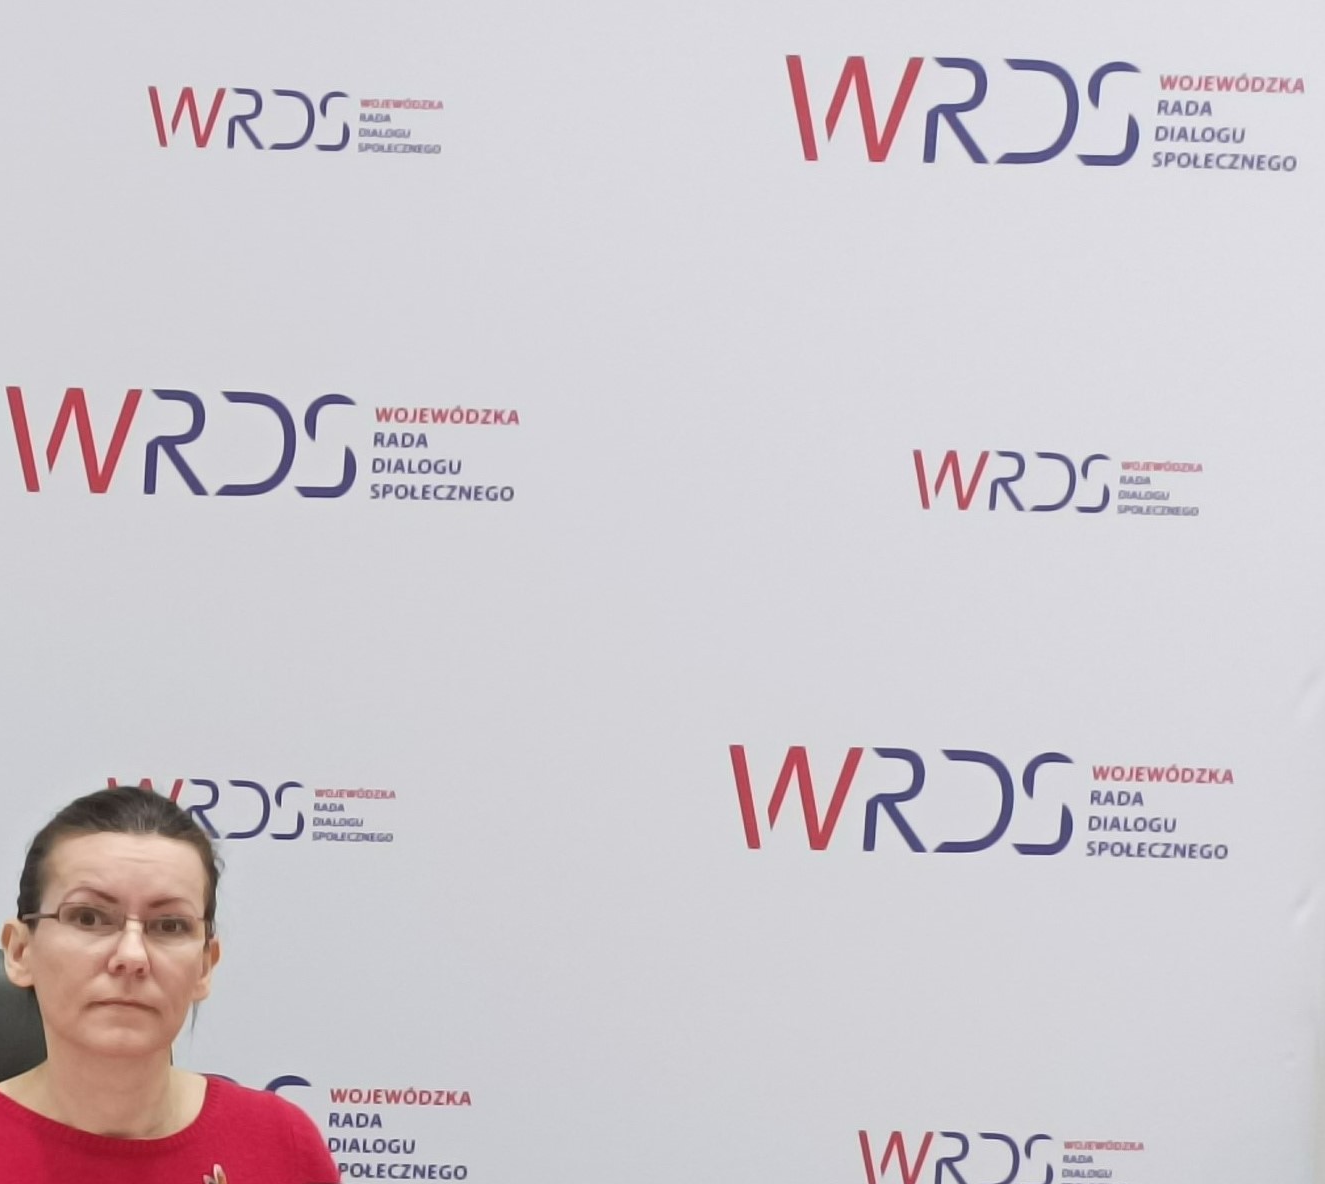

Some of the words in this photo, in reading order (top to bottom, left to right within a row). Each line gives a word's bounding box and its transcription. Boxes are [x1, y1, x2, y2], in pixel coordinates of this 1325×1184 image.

[1160, 74, 1304, 93] WOJEWÓDZKA
[786, 55, 1140, 166] WRDS
[1158, 100, 1212, 116] RADA
[148, 86, 350, 151] WRDS
[1155, 126, 1245, 143] DIALOGU
[1153, 152, 1297, 171] SPOŁECZNEGO
[376, 406, 519, 425] WOJEWÓDZKA
[6, 386, 356, 498] WRDS
[374, 432, 428, 448] RADA
[372, 458, 461, 475] DIALOGU
[913, 450, 1110, 513] WRDS
[371, 484, 514, 501] SPOŁECZNEGO
[1093, 765, 1233, 784] WOJEWÓDZKA
[730, 745, 1073, 855] WRDS
[1091, 790, 1143, 806] RADA
[107, 777, 305, 840] RDS
[1088, 816, 1176, 833] DIALOGU
[1087, 841, 1228, 859] SPOŁECZNEGO
[330, 1088, 471, 1105] WOJEWÓDZKA
[329, 1113, 382, 1128] RADA
[328, 1137, 416, 1154] DIALOGU
[338, 1162, 468, 1181] POŁECZNEGO
